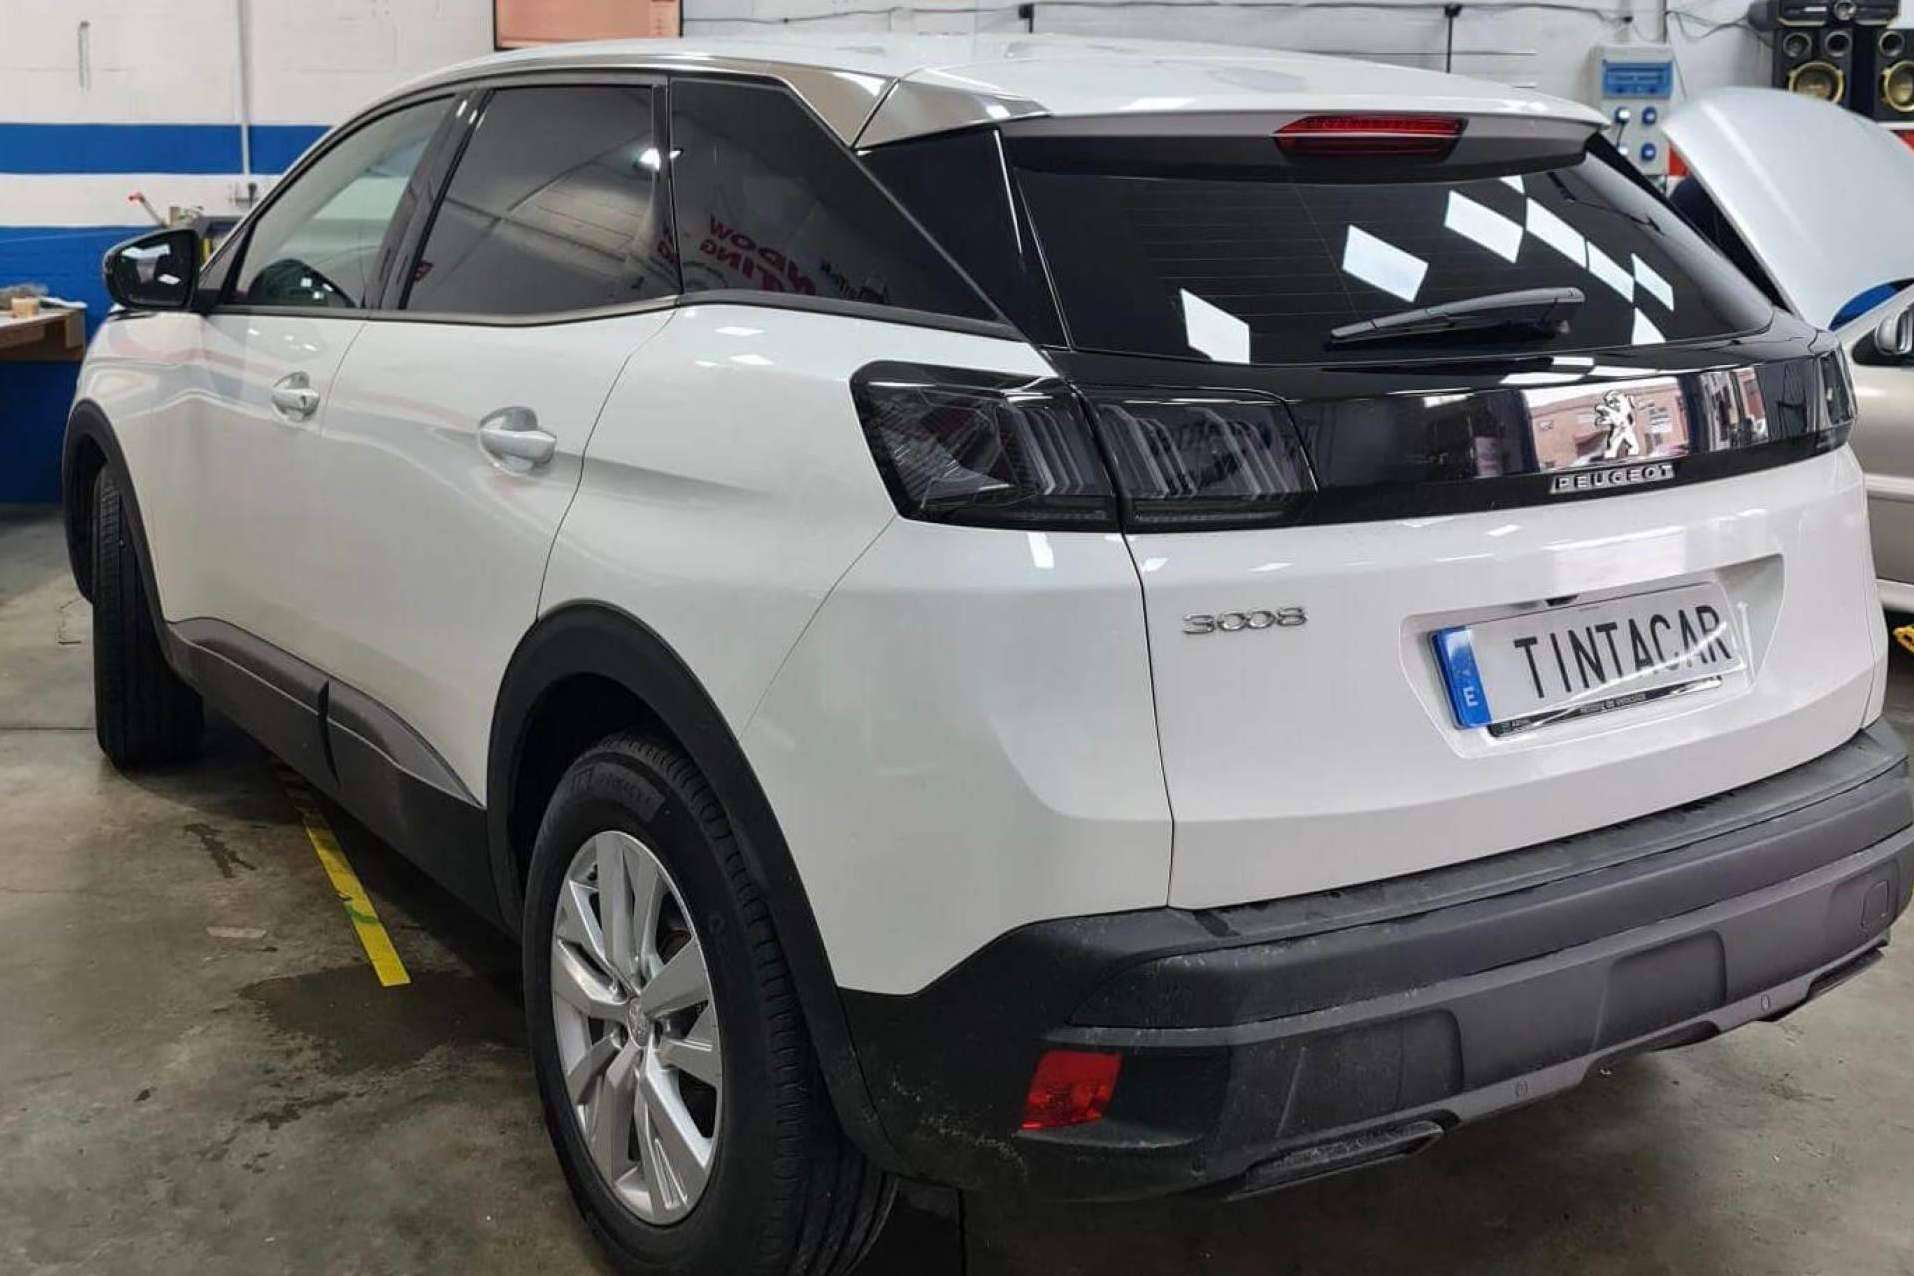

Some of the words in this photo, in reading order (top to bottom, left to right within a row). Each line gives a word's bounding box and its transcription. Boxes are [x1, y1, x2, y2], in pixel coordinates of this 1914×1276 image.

[1555, 465, 1674, 491] PEUGEOT
[1183, 607, 1308, 634] 3008
[1513, 606, 1732, 699] TINTACAR
[1462, 687, 1478, 707] E
